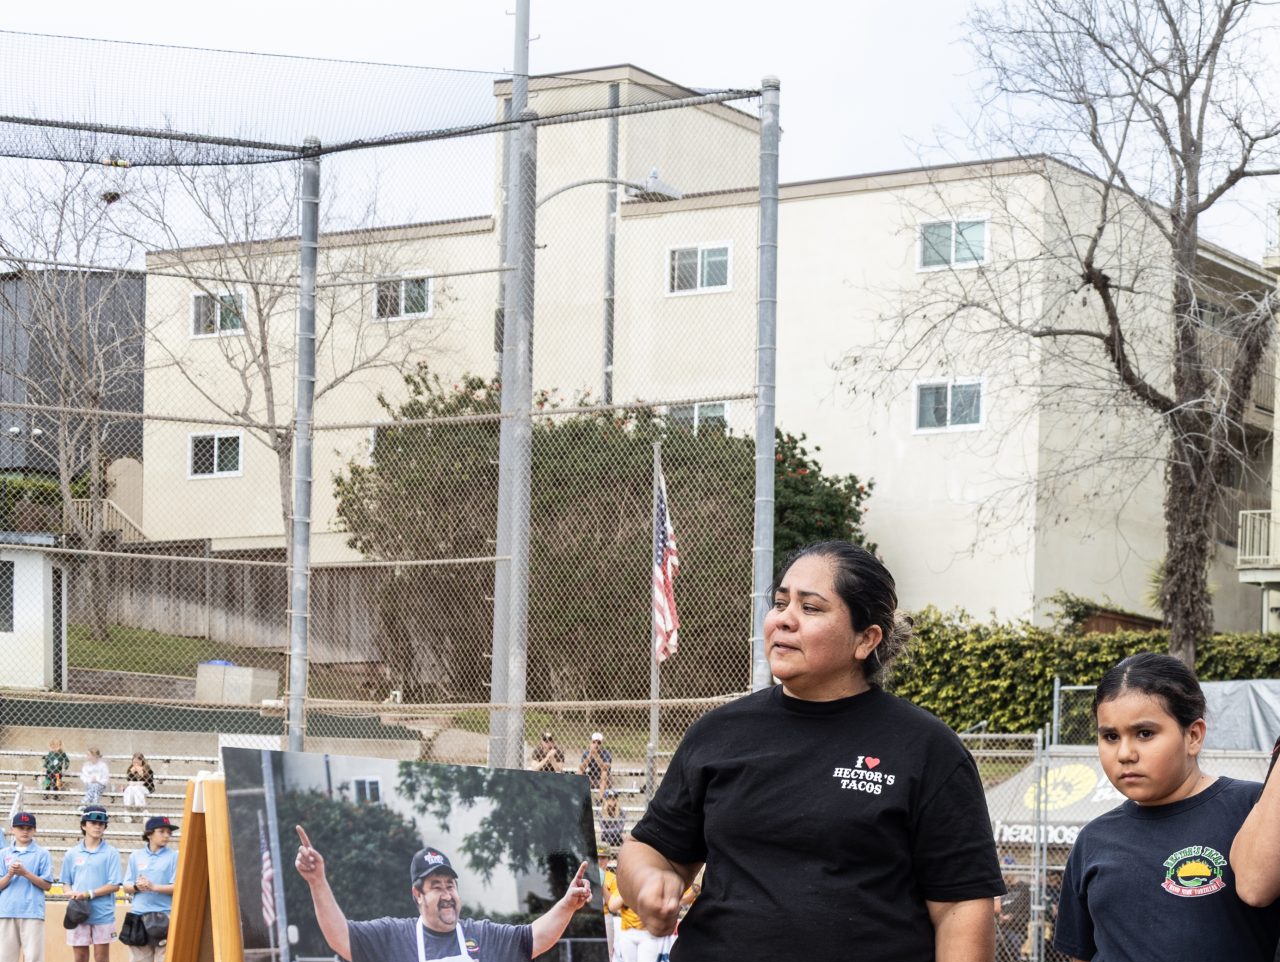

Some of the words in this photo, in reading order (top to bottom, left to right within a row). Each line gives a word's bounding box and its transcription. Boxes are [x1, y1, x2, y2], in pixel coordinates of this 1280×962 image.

[855, 755, 865, 769] I
[833, 767, 895, 786] HECTOR'S
[840, 779, 883, 795] TACOS
[1201, 846, 1228, 867] TACOS
